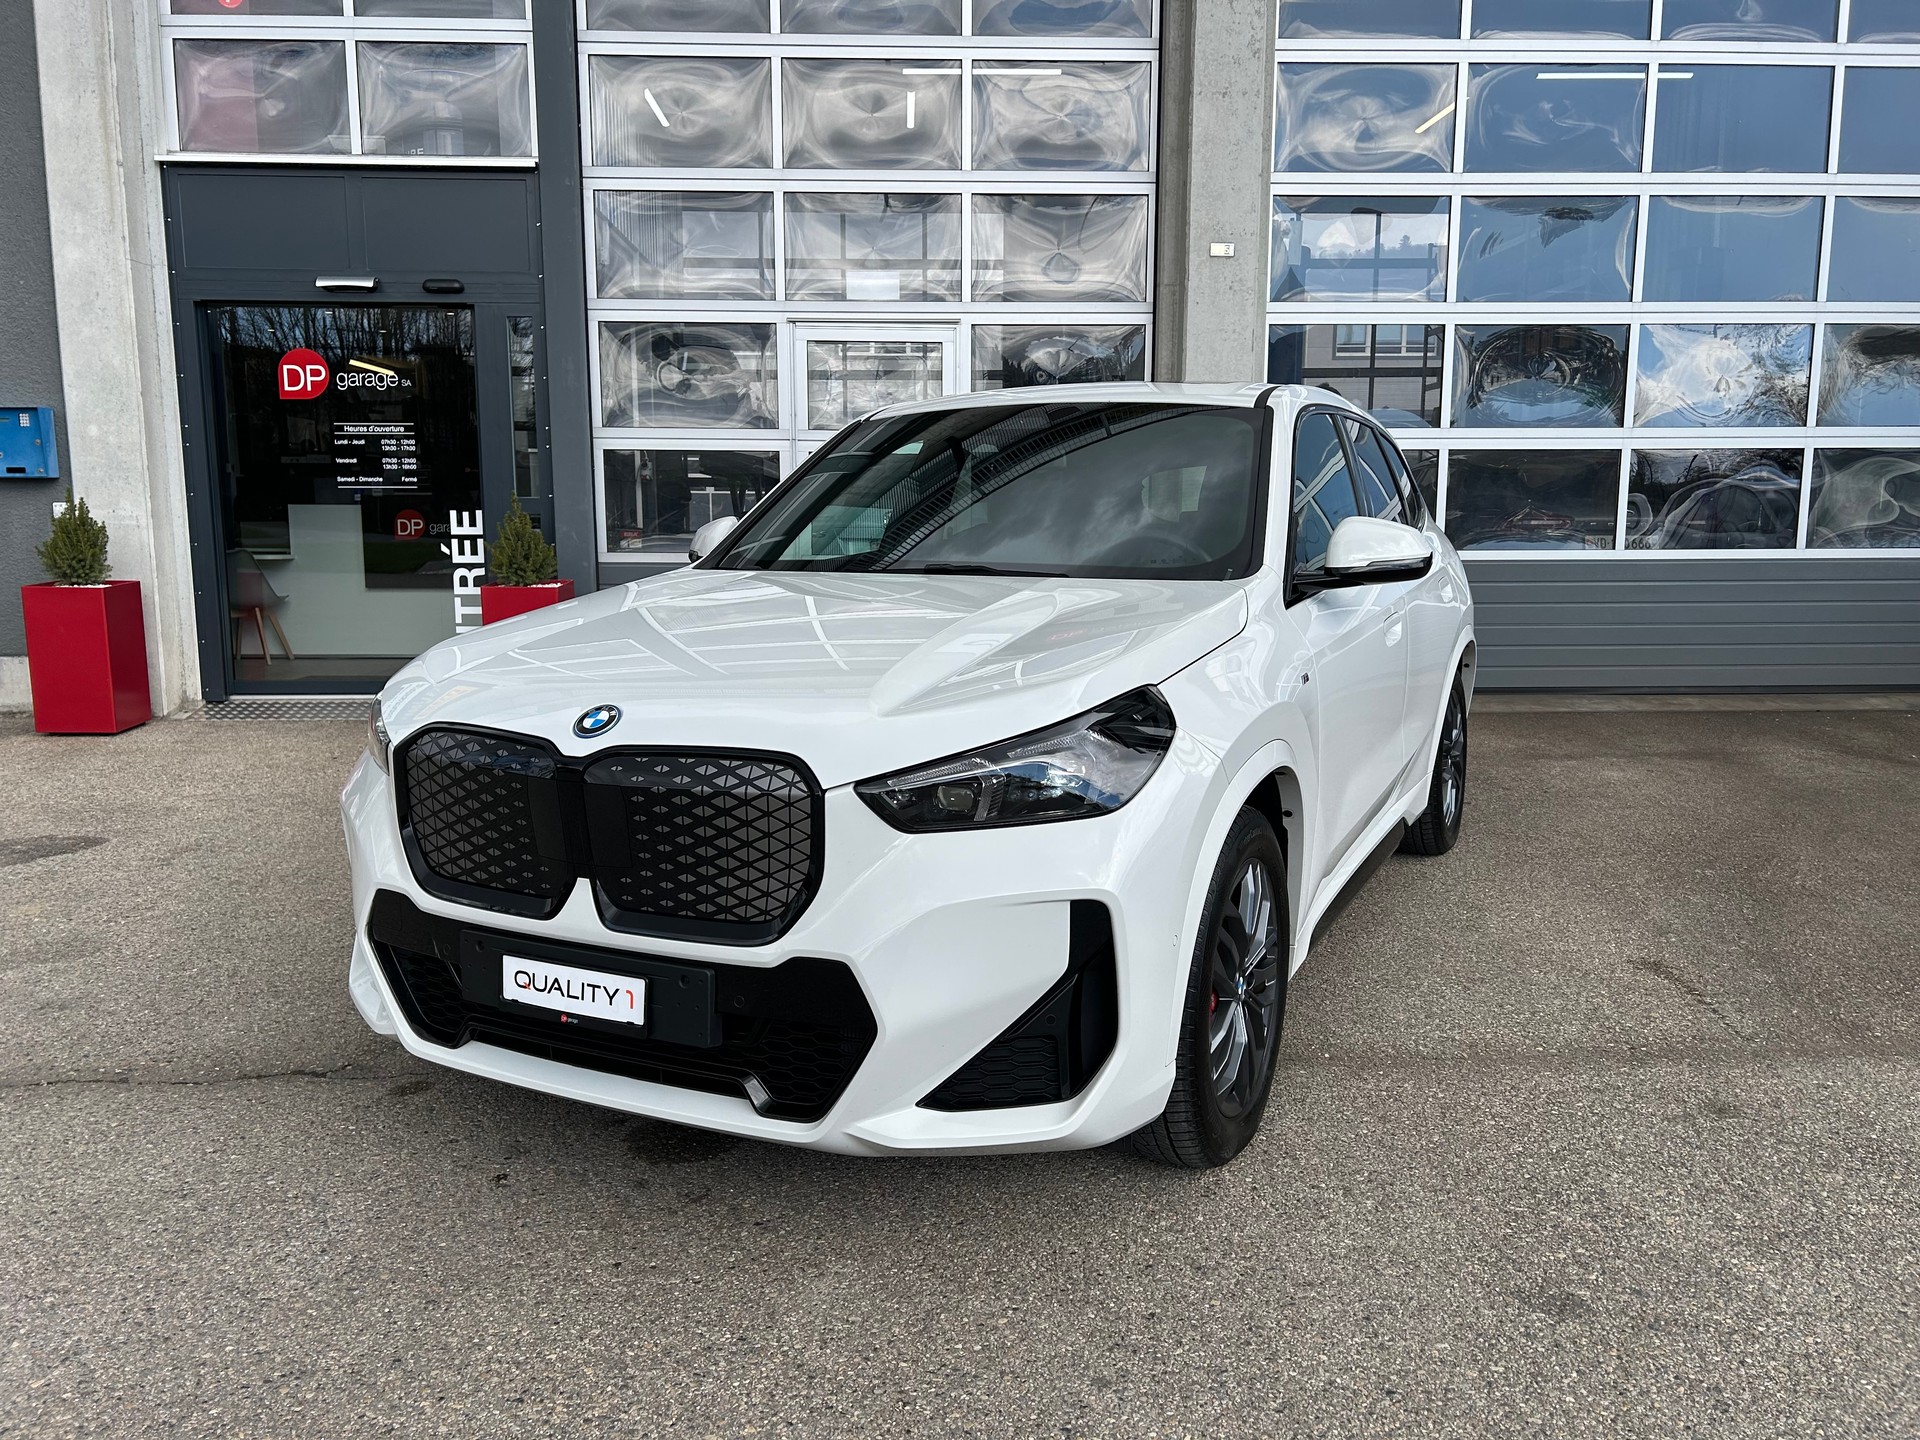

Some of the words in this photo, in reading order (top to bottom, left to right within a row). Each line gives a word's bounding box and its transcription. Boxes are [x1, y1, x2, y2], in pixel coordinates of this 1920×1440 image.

[282, 364, 326, 392] DP
[336, 372, 399, 391] garage
[401, 379, 412, 387] SA
[397, 519, 424, 535] DP
[429, 523, 452, 535] gara
[440, 509, 486, 634] TRÉE
[514, 970, 620, 1006] QUALITY
[625, 989, 634, 1009] 1
